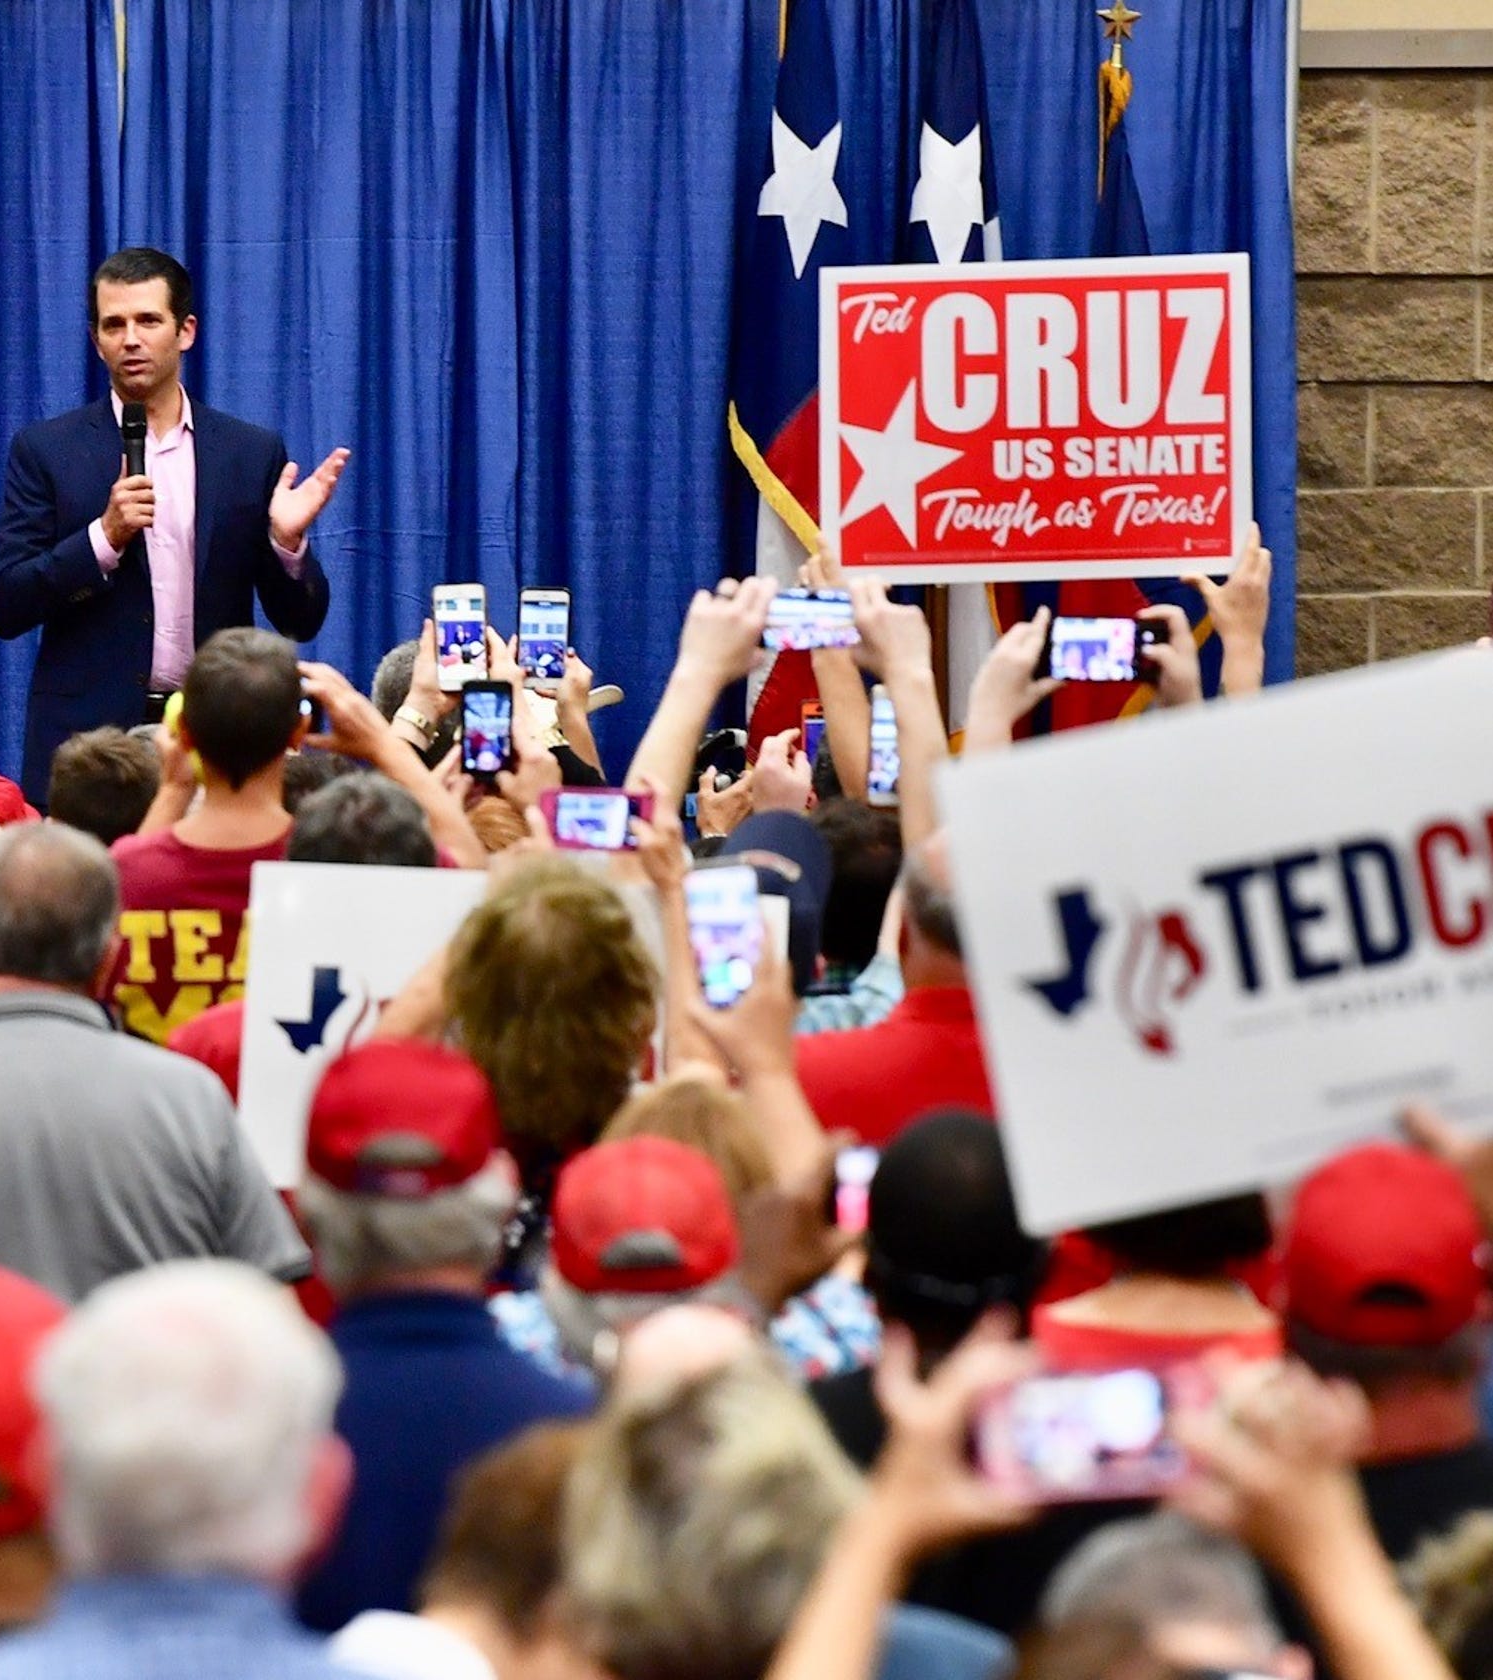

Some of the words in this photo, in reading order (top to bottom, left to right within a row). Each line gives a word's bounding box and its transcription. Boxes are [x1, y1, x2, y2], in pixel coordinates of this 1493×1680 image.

[841, 292, 917, 344] Ted
[921, 287, 1226, 434] CRUZ
[993, 438, 1056, 480] US
[1064, 434, 1226, 478] SENATE
[921, 487, 1051, 547] Tough
[1054, 497, 1094, 529] as
[1100, 483, 1227, 536] Texas!
[1199, 807, 1493, 994] TEDC
